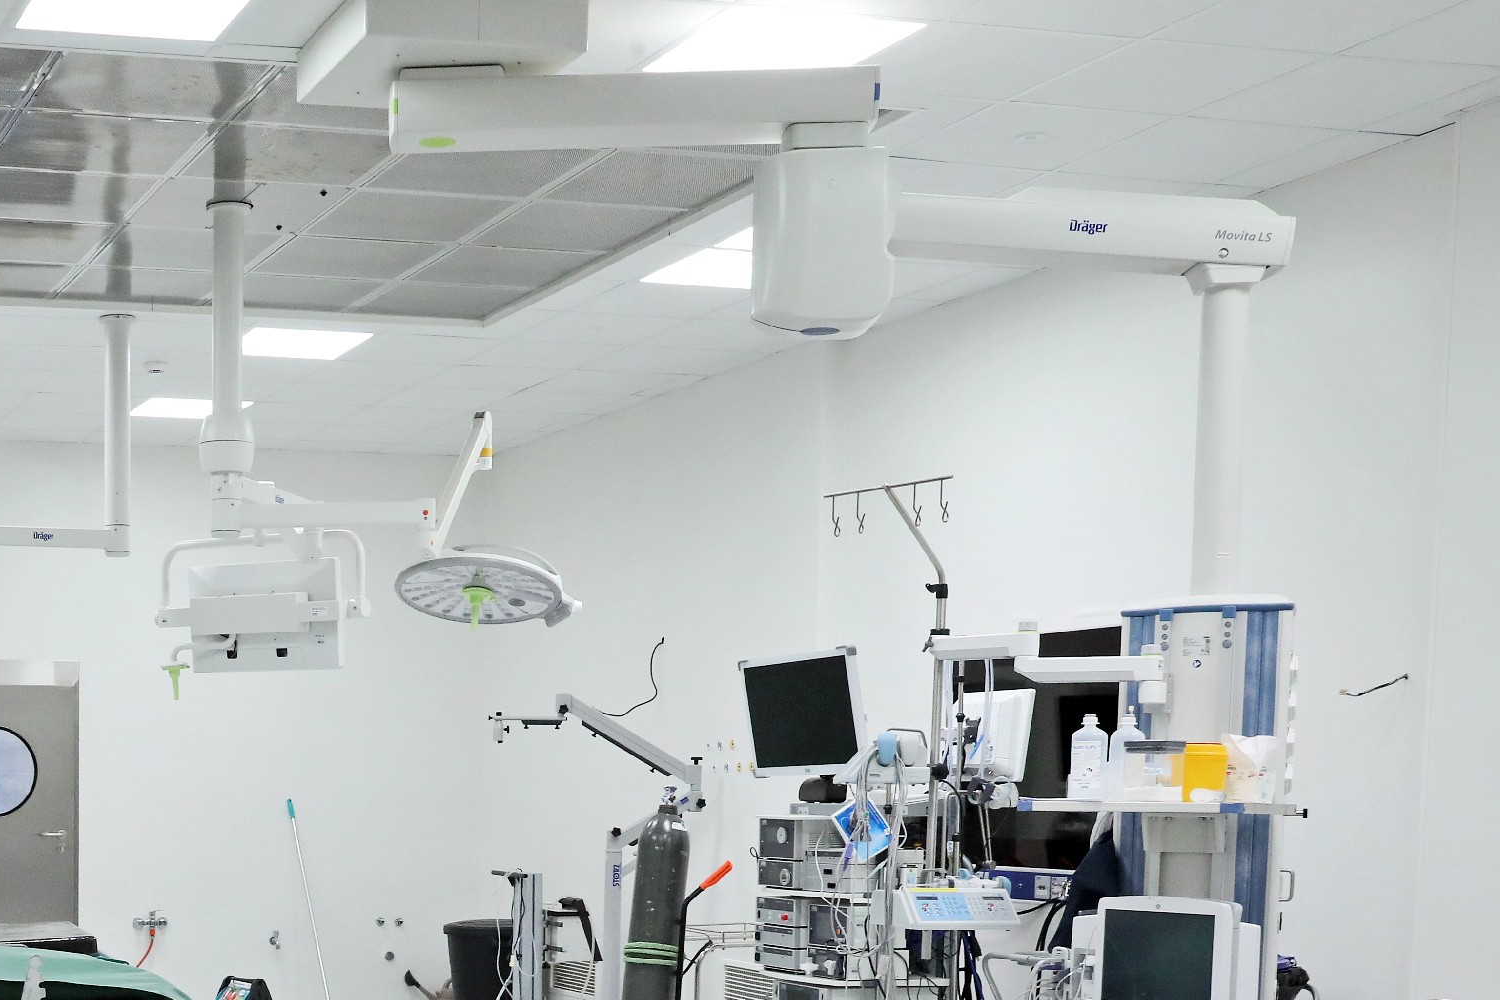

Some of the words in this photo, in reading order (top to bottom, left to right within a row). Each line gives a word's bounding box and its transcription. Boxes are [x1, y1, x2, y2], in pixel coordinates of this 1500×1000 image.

[1069, 219, 1108, 235] Dräger
[1214, 229, 1256, 242] Movita
[1258, 231, 1273, 242] LS
